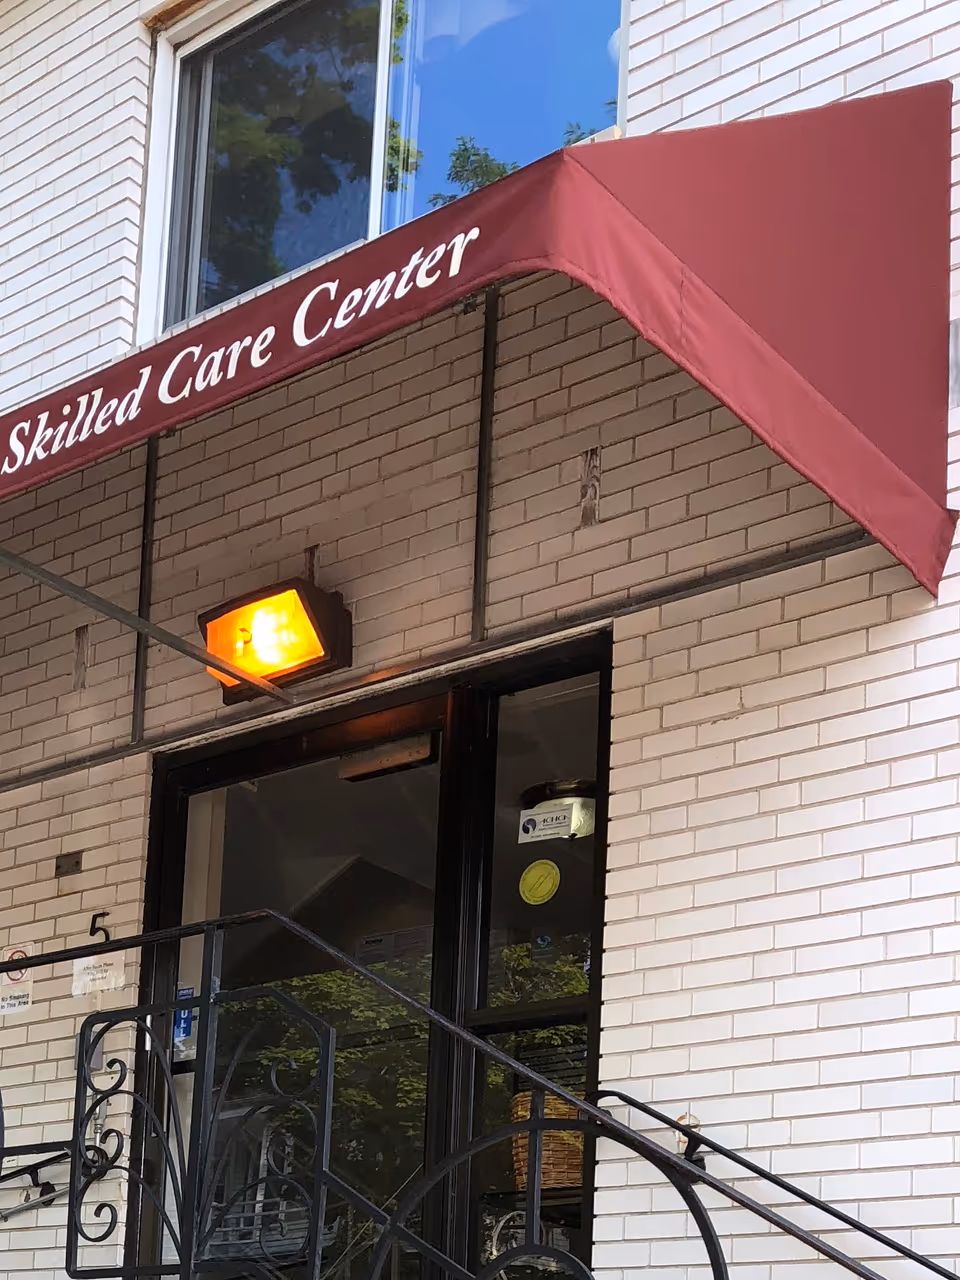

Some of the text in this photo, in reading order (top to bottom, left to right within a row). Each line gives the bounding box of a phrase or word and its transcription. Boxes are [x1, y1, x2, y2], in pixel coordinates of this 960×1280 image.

[1, 366, 152, 474] Skilled
[158, 326, 276, 404] Care
[293, 227, 480, 346] Center
[89, 911, 110, 942] 5
[8, 992, 30, 1002] Smoking
[180, 1009, 189, 1037] ULL
